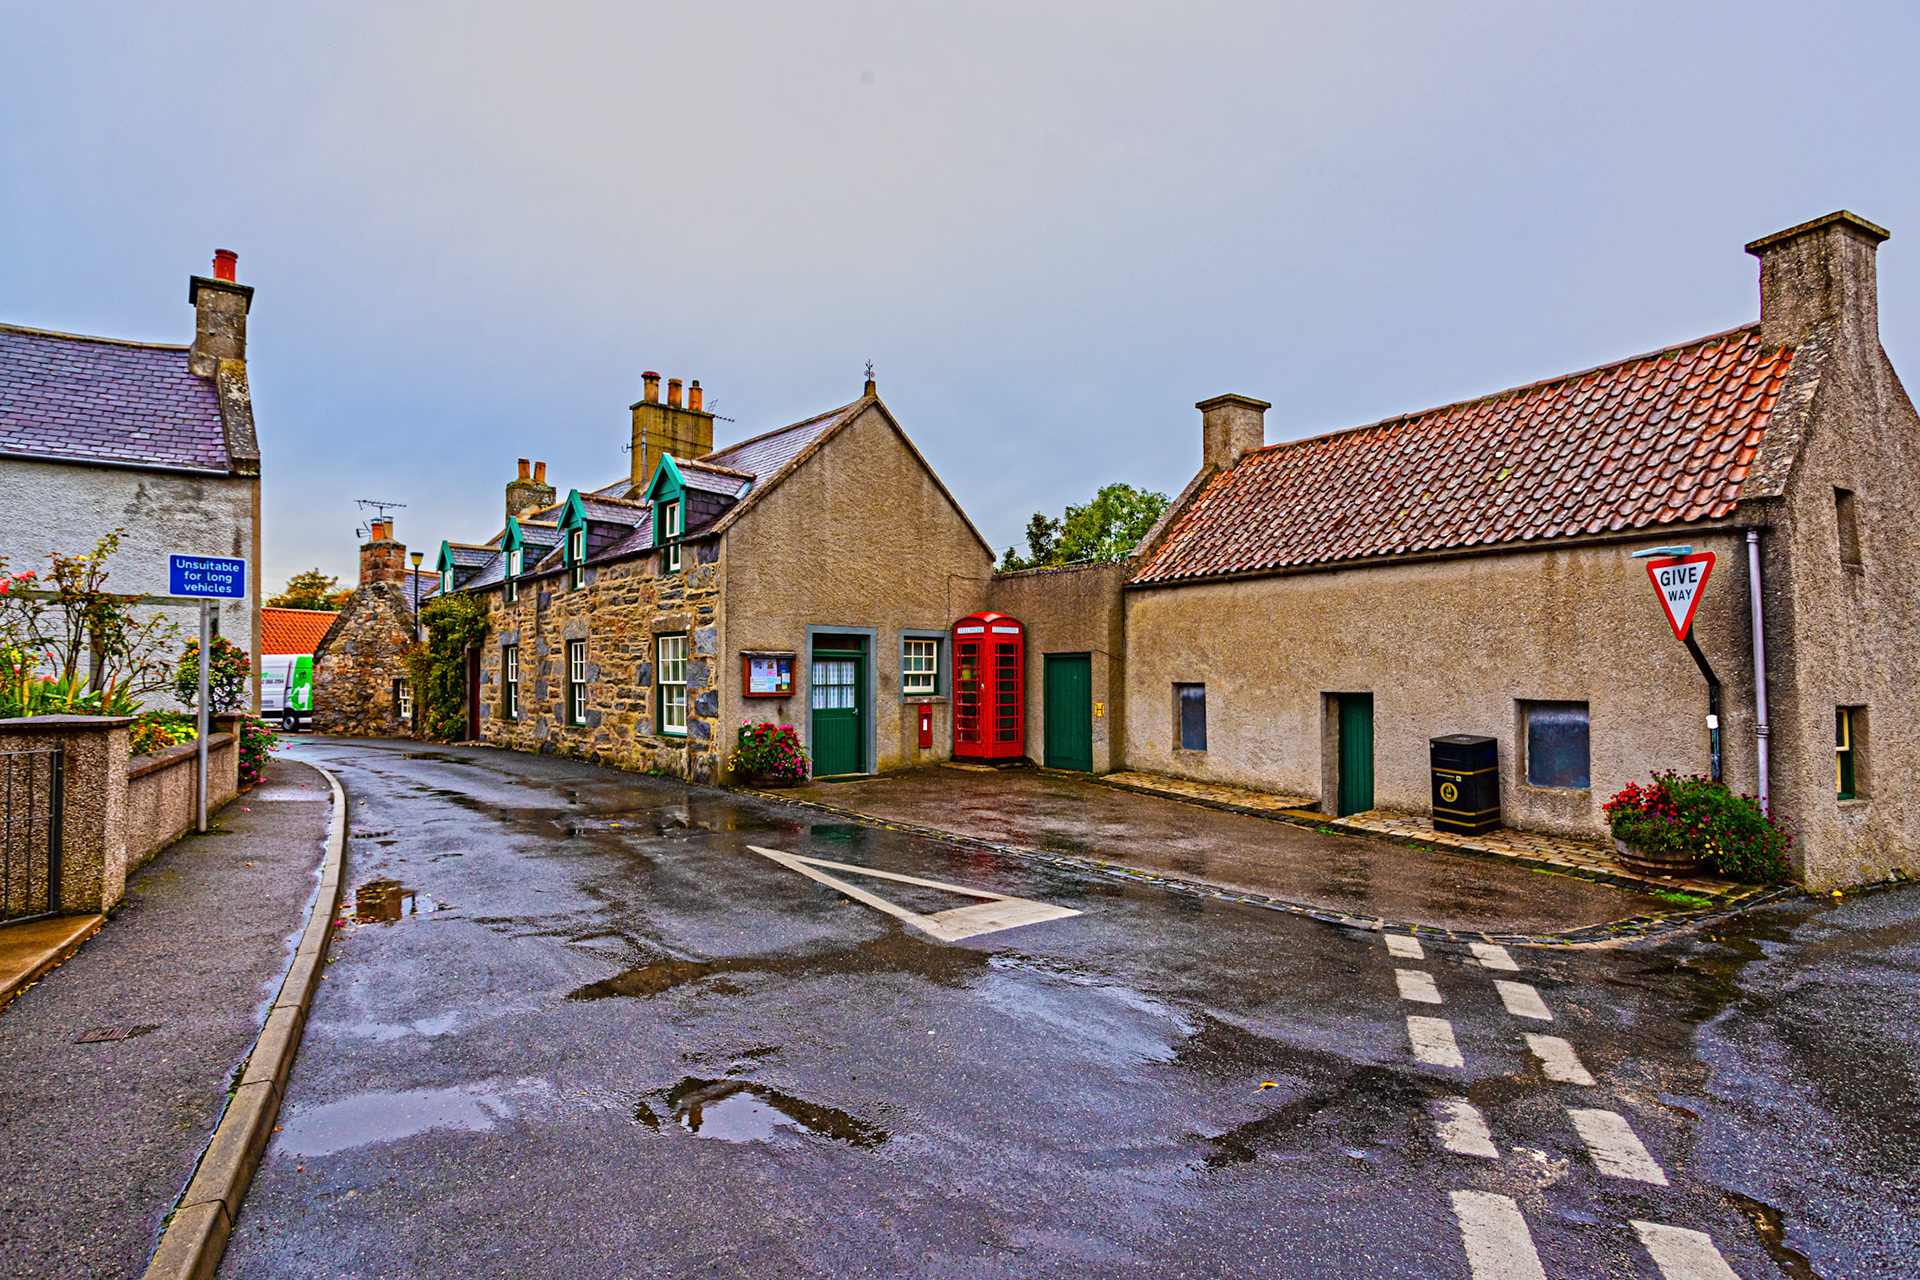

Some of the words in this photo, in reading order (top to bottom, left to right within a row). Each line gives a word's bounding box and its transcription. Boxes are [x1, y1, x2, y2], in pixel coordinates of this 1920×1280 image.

[176, 559, 240, 573] Unsuitable
[184, 571, 202, 581] for
[207, 571, 233, 584] long
[1660, 567, 1698, 587] GIVE
[184, 583, 232, 594] vehicles
[1668, 588, 1692, 602] WAY
